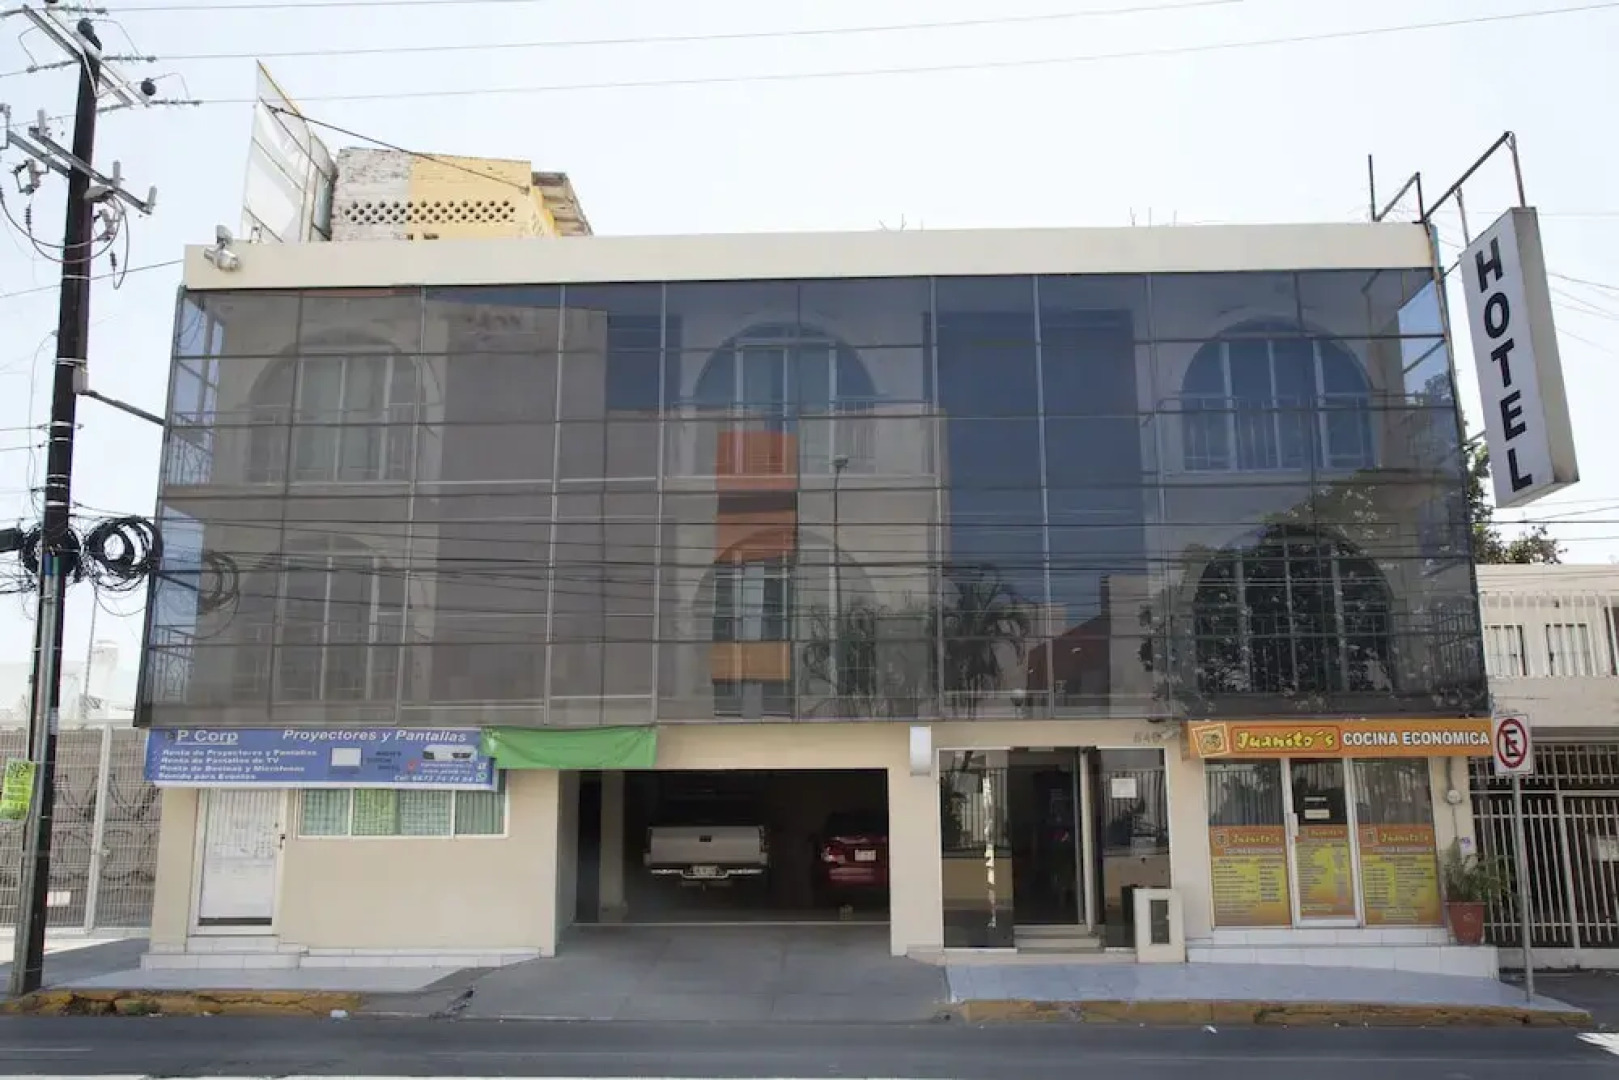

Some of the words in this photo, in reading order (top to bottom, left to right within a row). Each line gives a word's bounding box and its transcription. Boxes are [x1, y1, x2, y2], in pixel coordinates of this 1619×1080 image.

[1475, 237, 1533, 492] HOTEL
[194, 729, 239, 746] Corp
[282, 729, 377, 742] Proyectores
[381, 731, 392, 743] y
[395, 729, 467, 742] Pantallas
[1343, 732, 1398, 746] COCINA
